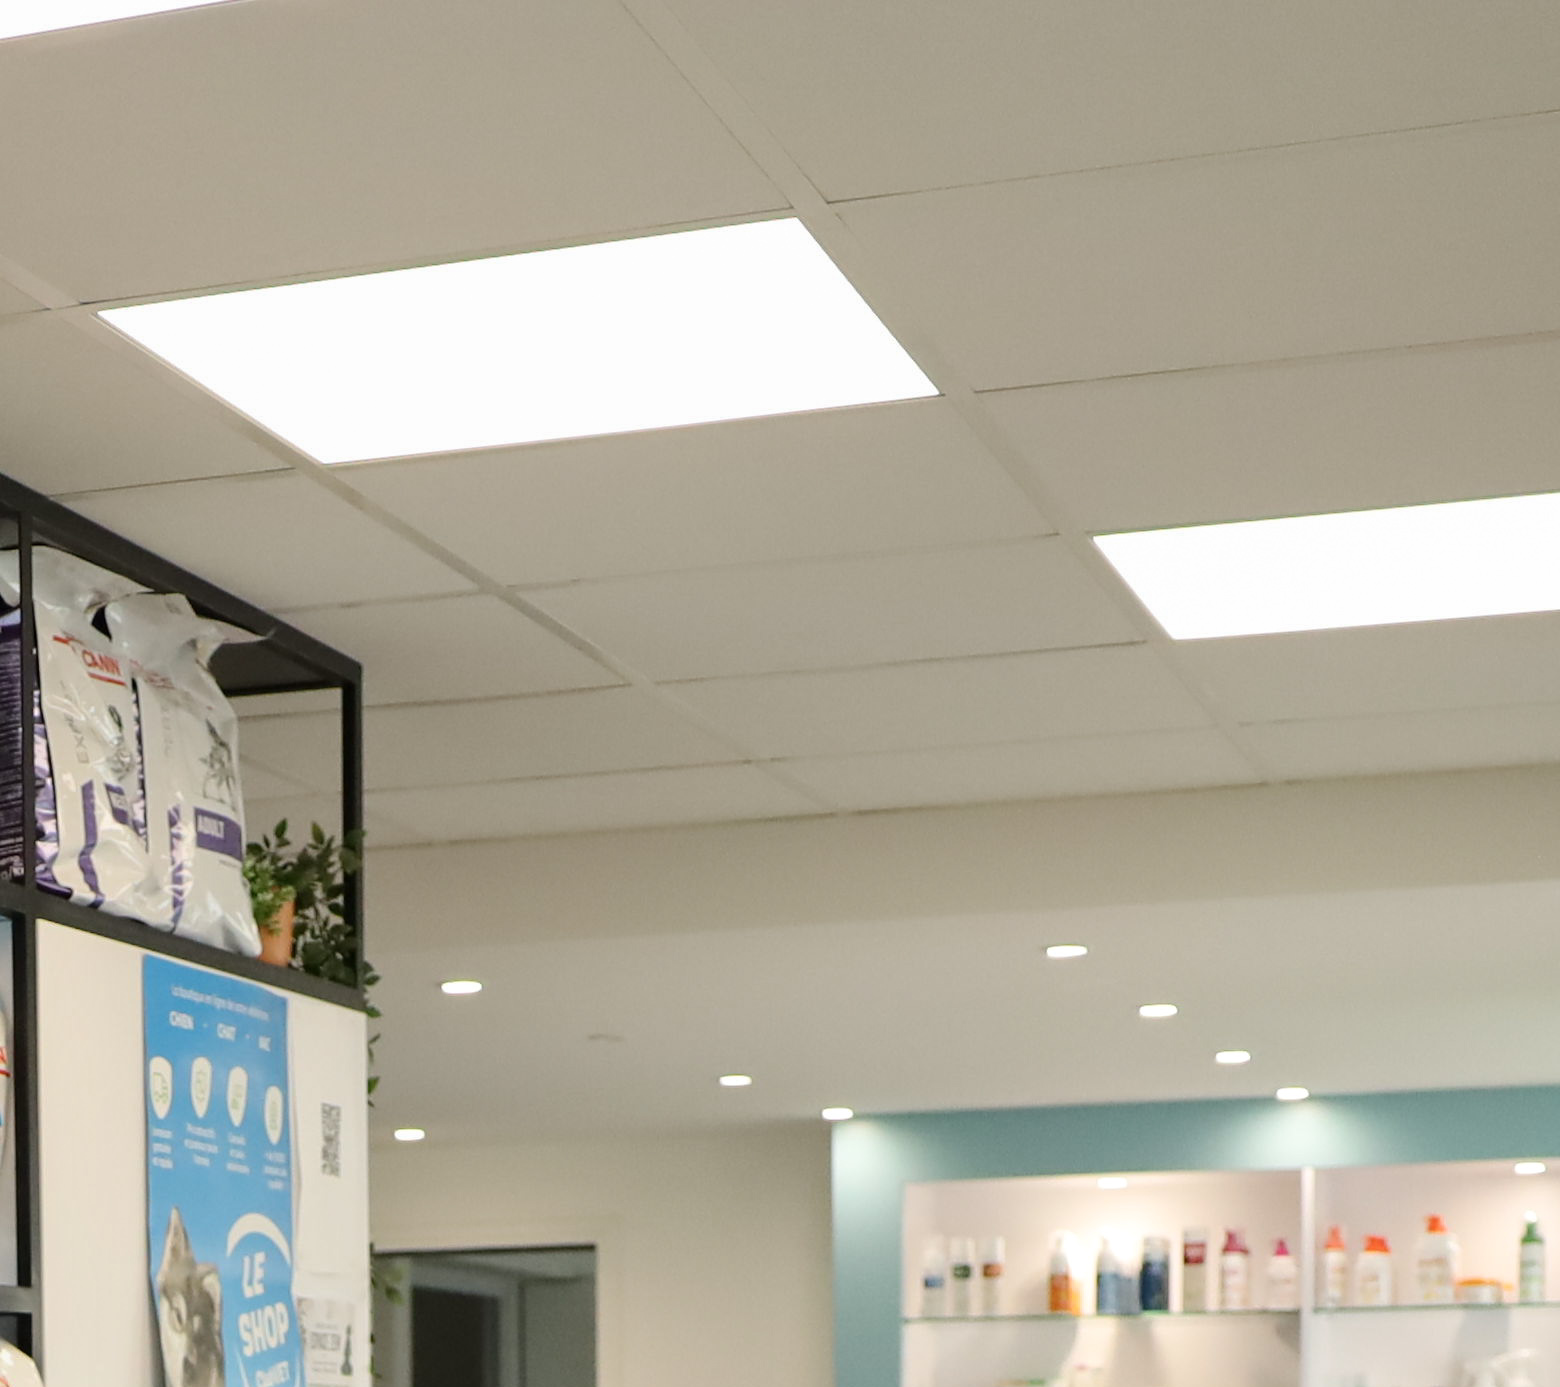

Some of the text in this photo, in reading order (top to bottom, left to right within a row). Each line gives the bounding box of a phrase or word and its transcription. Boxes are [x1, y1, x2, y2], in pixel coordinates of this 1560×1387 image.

[196, 814, 225, 839] ADULT
[241, 1251, 266, 1298] LE
[237, 1301, 290, 1358] SHOP
